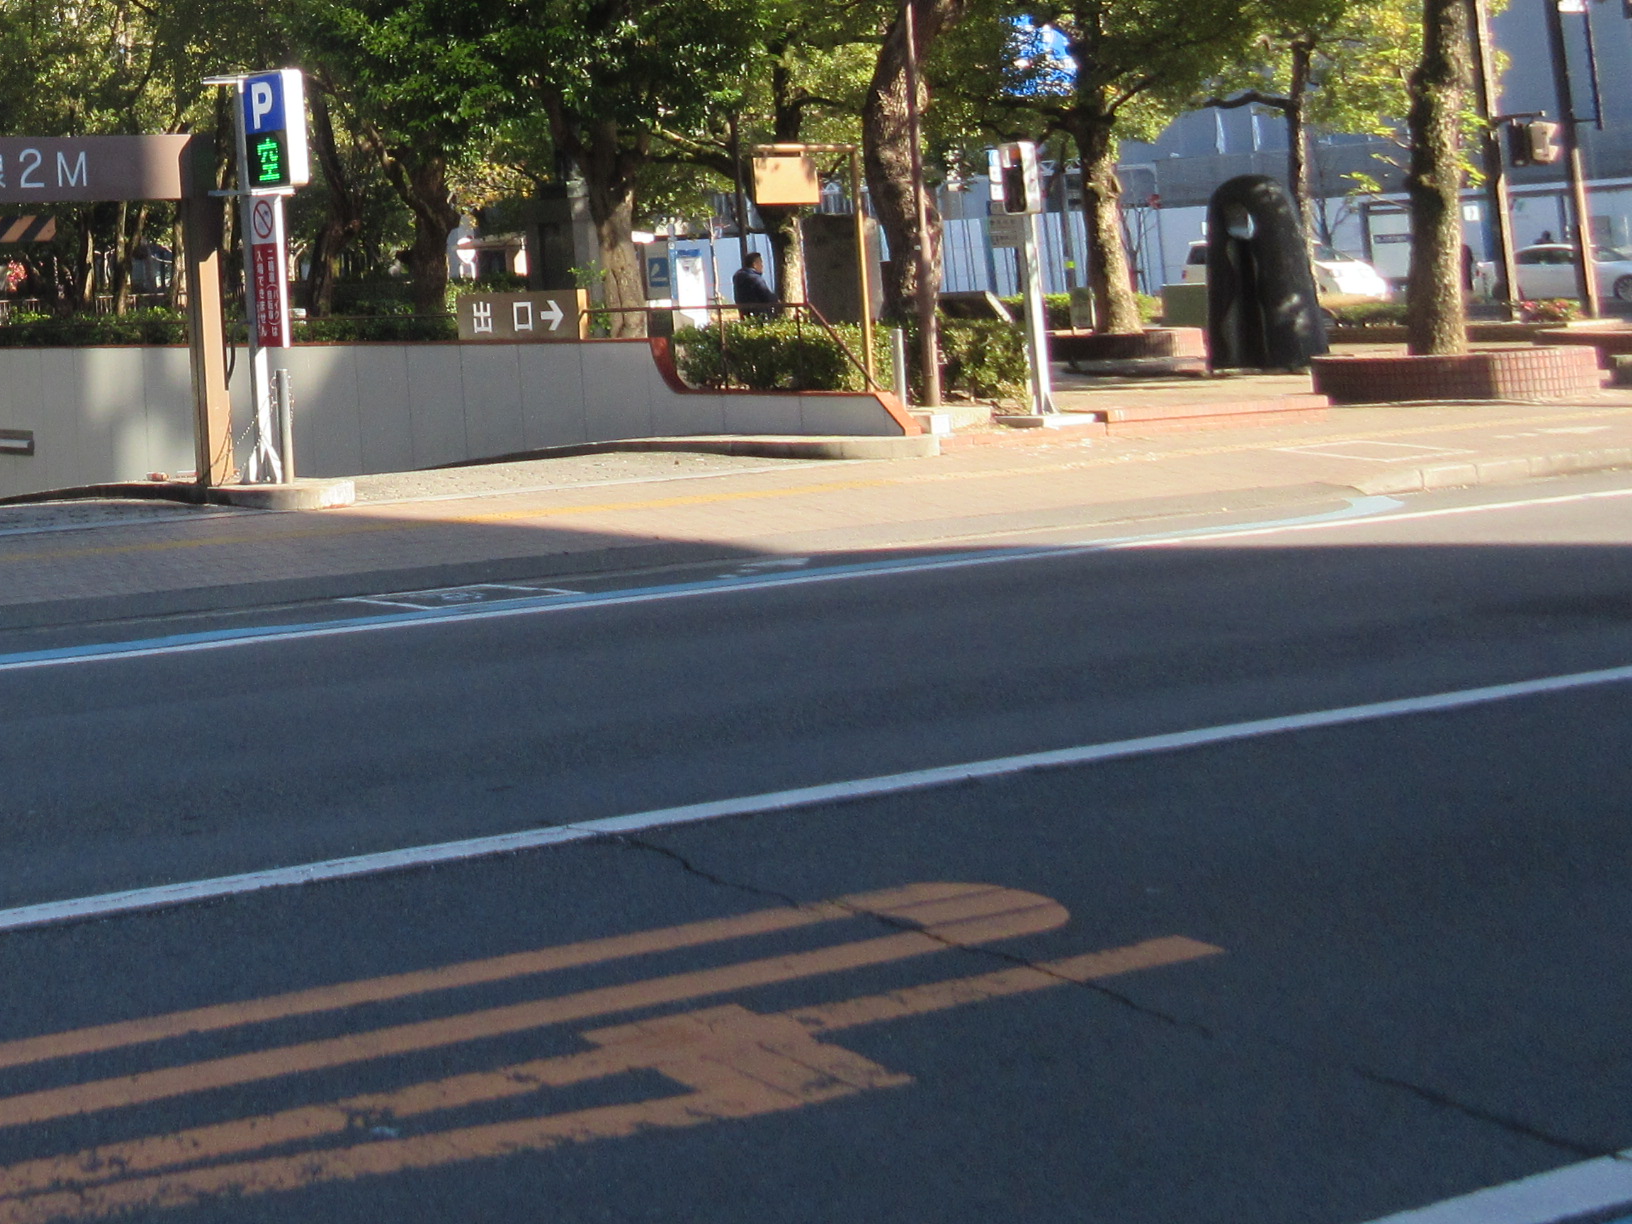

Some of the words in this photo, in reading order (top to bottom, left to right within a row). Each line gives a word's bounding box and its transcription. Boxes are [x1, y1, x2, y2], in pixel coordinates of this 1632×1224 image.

[251, 81, 273, 130] P
[256, 138, 280, 181] 空
[472, 301, 534, 334] 出口
